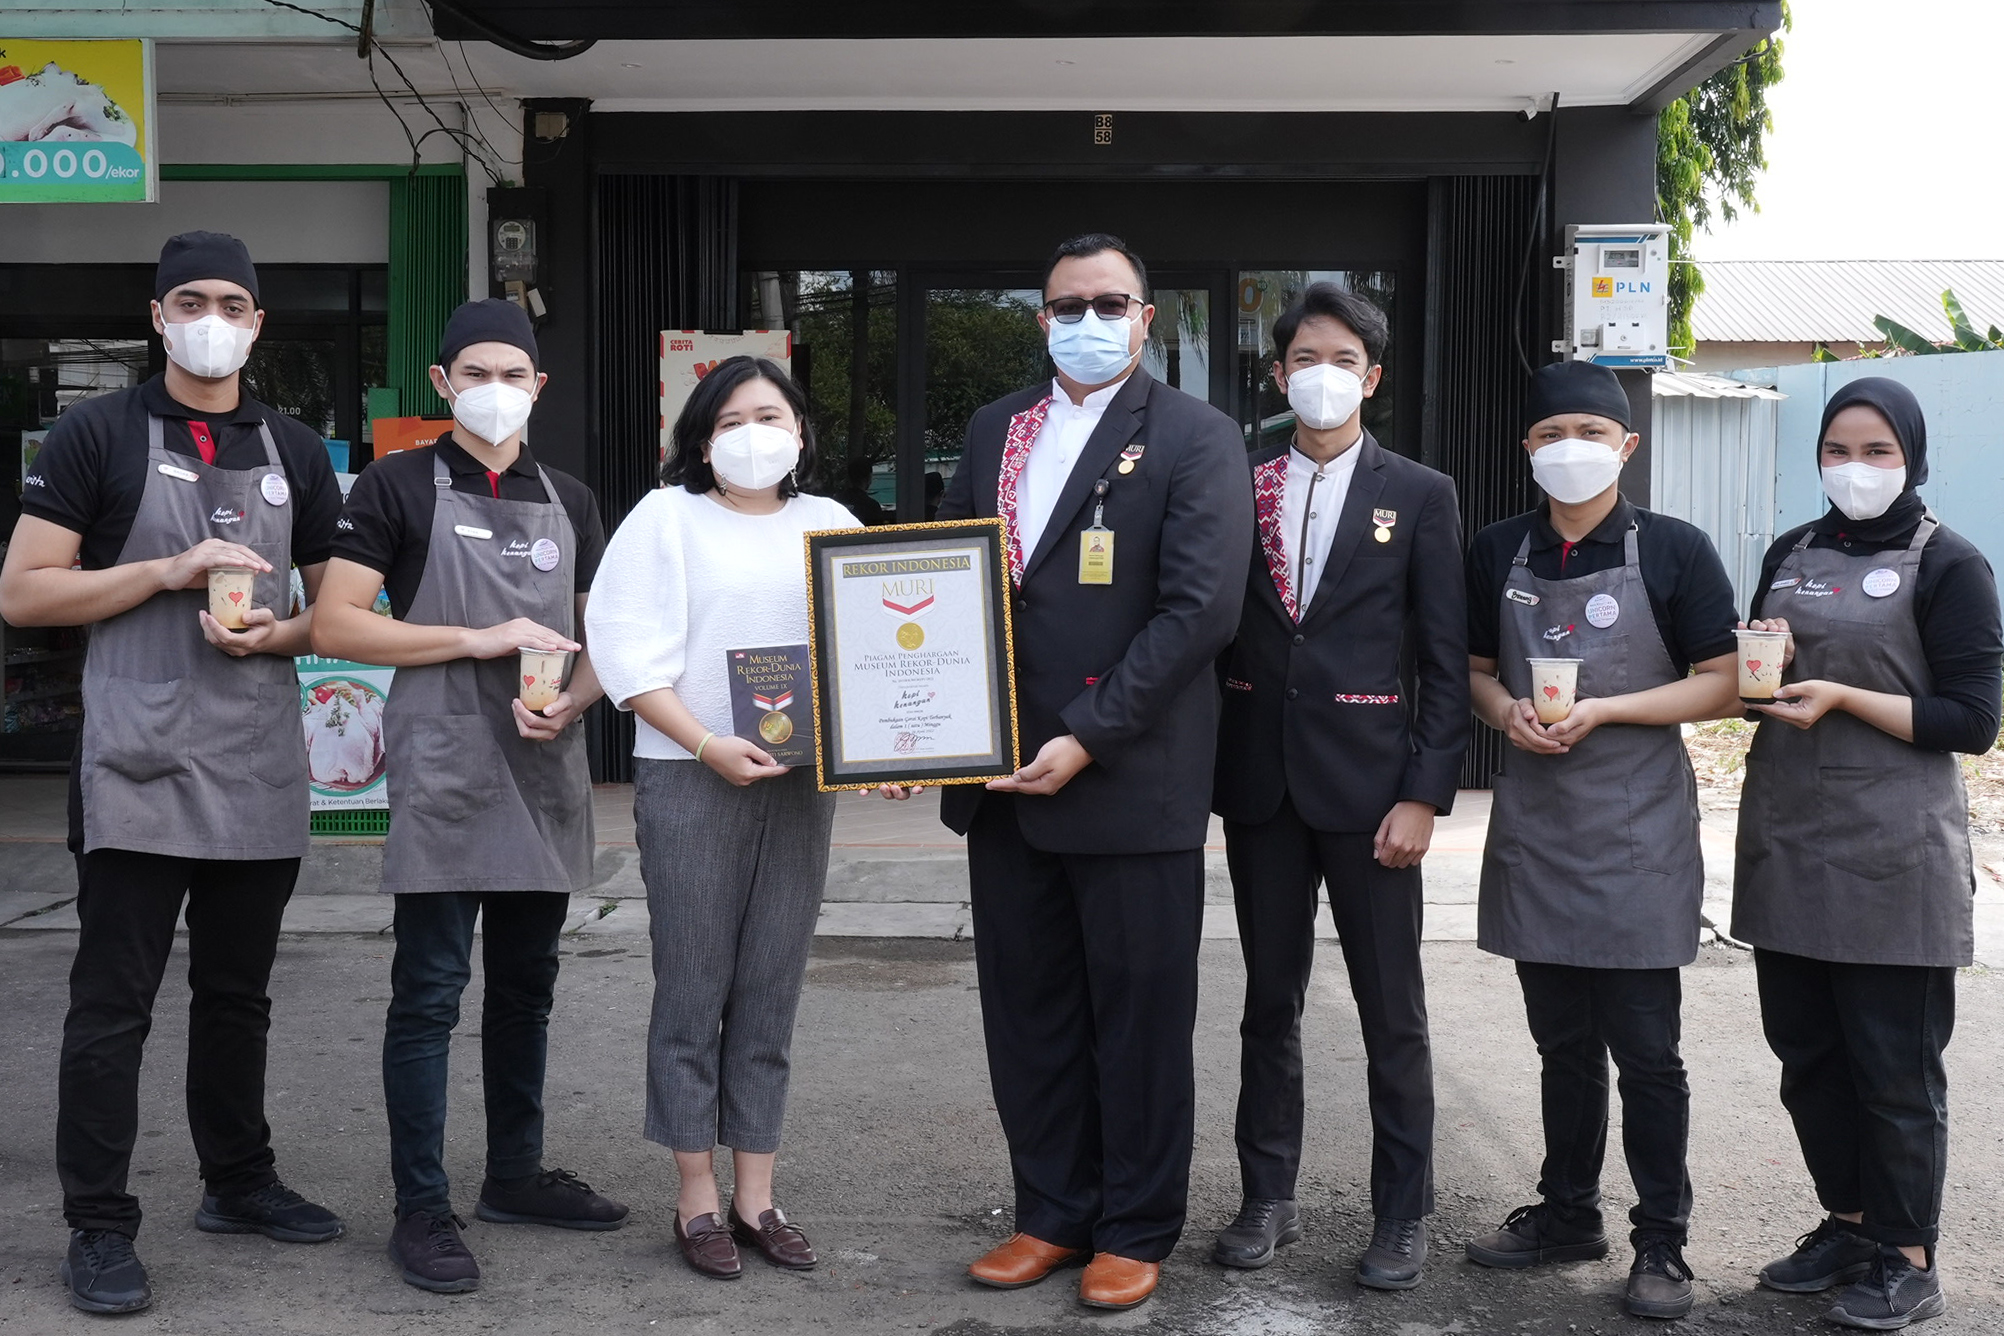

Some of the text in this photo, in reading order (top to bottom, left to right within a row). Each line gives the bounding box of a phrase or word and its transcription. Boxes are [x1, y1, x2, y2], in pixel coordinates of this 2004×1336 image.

[1095, 116, 1112, 128] B8
[1095, 131, 1111, 143] 58
[1616, 281, 1651, 293] PLN
[1373, 508, 1397, 519] MURI
[509, 540, 529, 549] kopi
[843, 557, 971, 576] REKOR INDONESIA
[882, 578, 935, 597] MURI
[1805, 578, 1828, 589] kopi
[1795, 585, 1834, 597] kenangan
[1587, 605, 1616, 613] UNICORN
[1588, 610, 1617, 619] PERTAMA
[749, 655, 788, 665] MUSEUM
[864, 650, 959, 662] PIAGAM PENGHARGAAN
[737, 662, 802, 675] REKOR-DUNIA
[854, 657, 971, 671] MUSEUM REKOR-DUNIA
[885, 667, 941, 678] INDONESIA
[746, 673, 794, 684] INDONESIA
[901, 690, 920, 700] kopi
[893, 698, 931, 709] kenangan
[328, 798, 364, 806] Ketentuan
